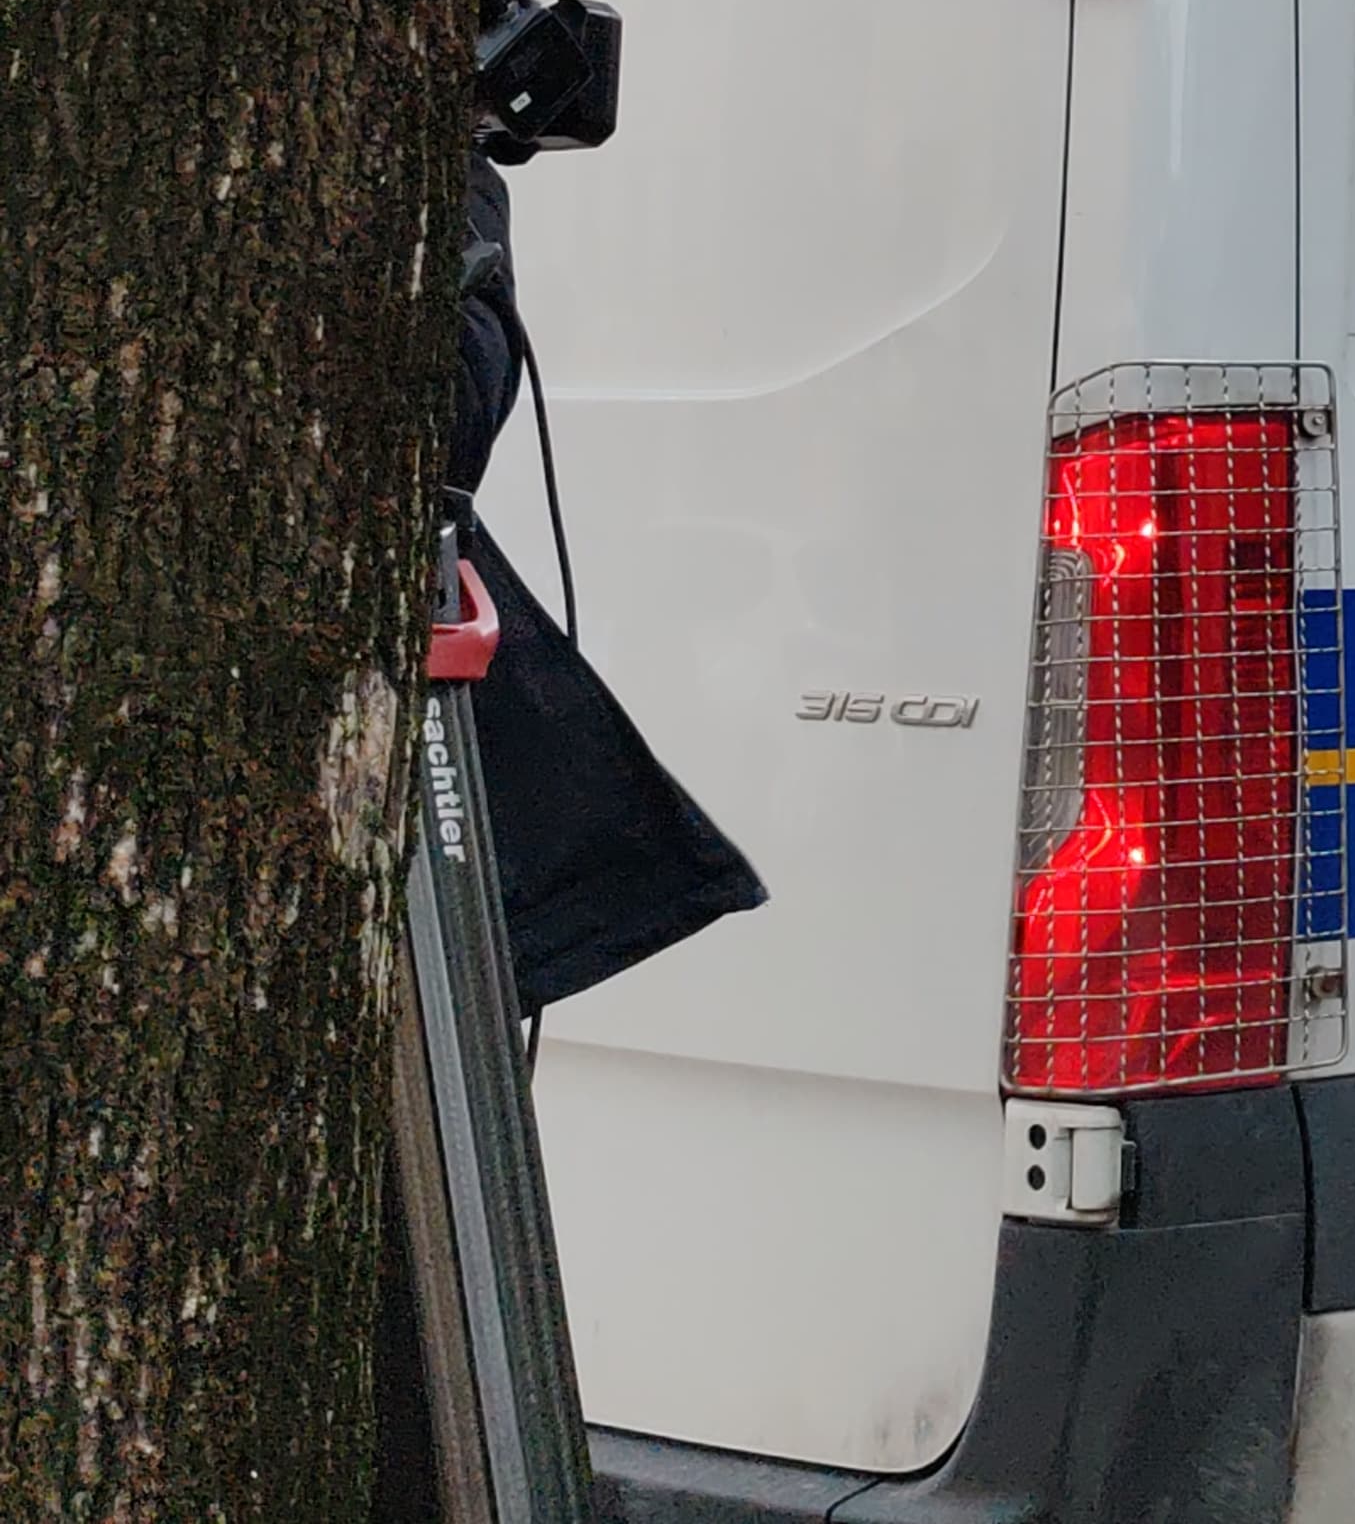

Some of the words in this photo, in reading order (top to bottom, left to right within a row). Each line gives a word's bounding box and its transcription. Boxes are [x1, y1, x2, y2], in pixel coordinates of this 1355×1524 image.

[795, 691, 885, 724] 315
[890, 694, 980, 729] CDI
[422, 697, 466, 864] sachtler
